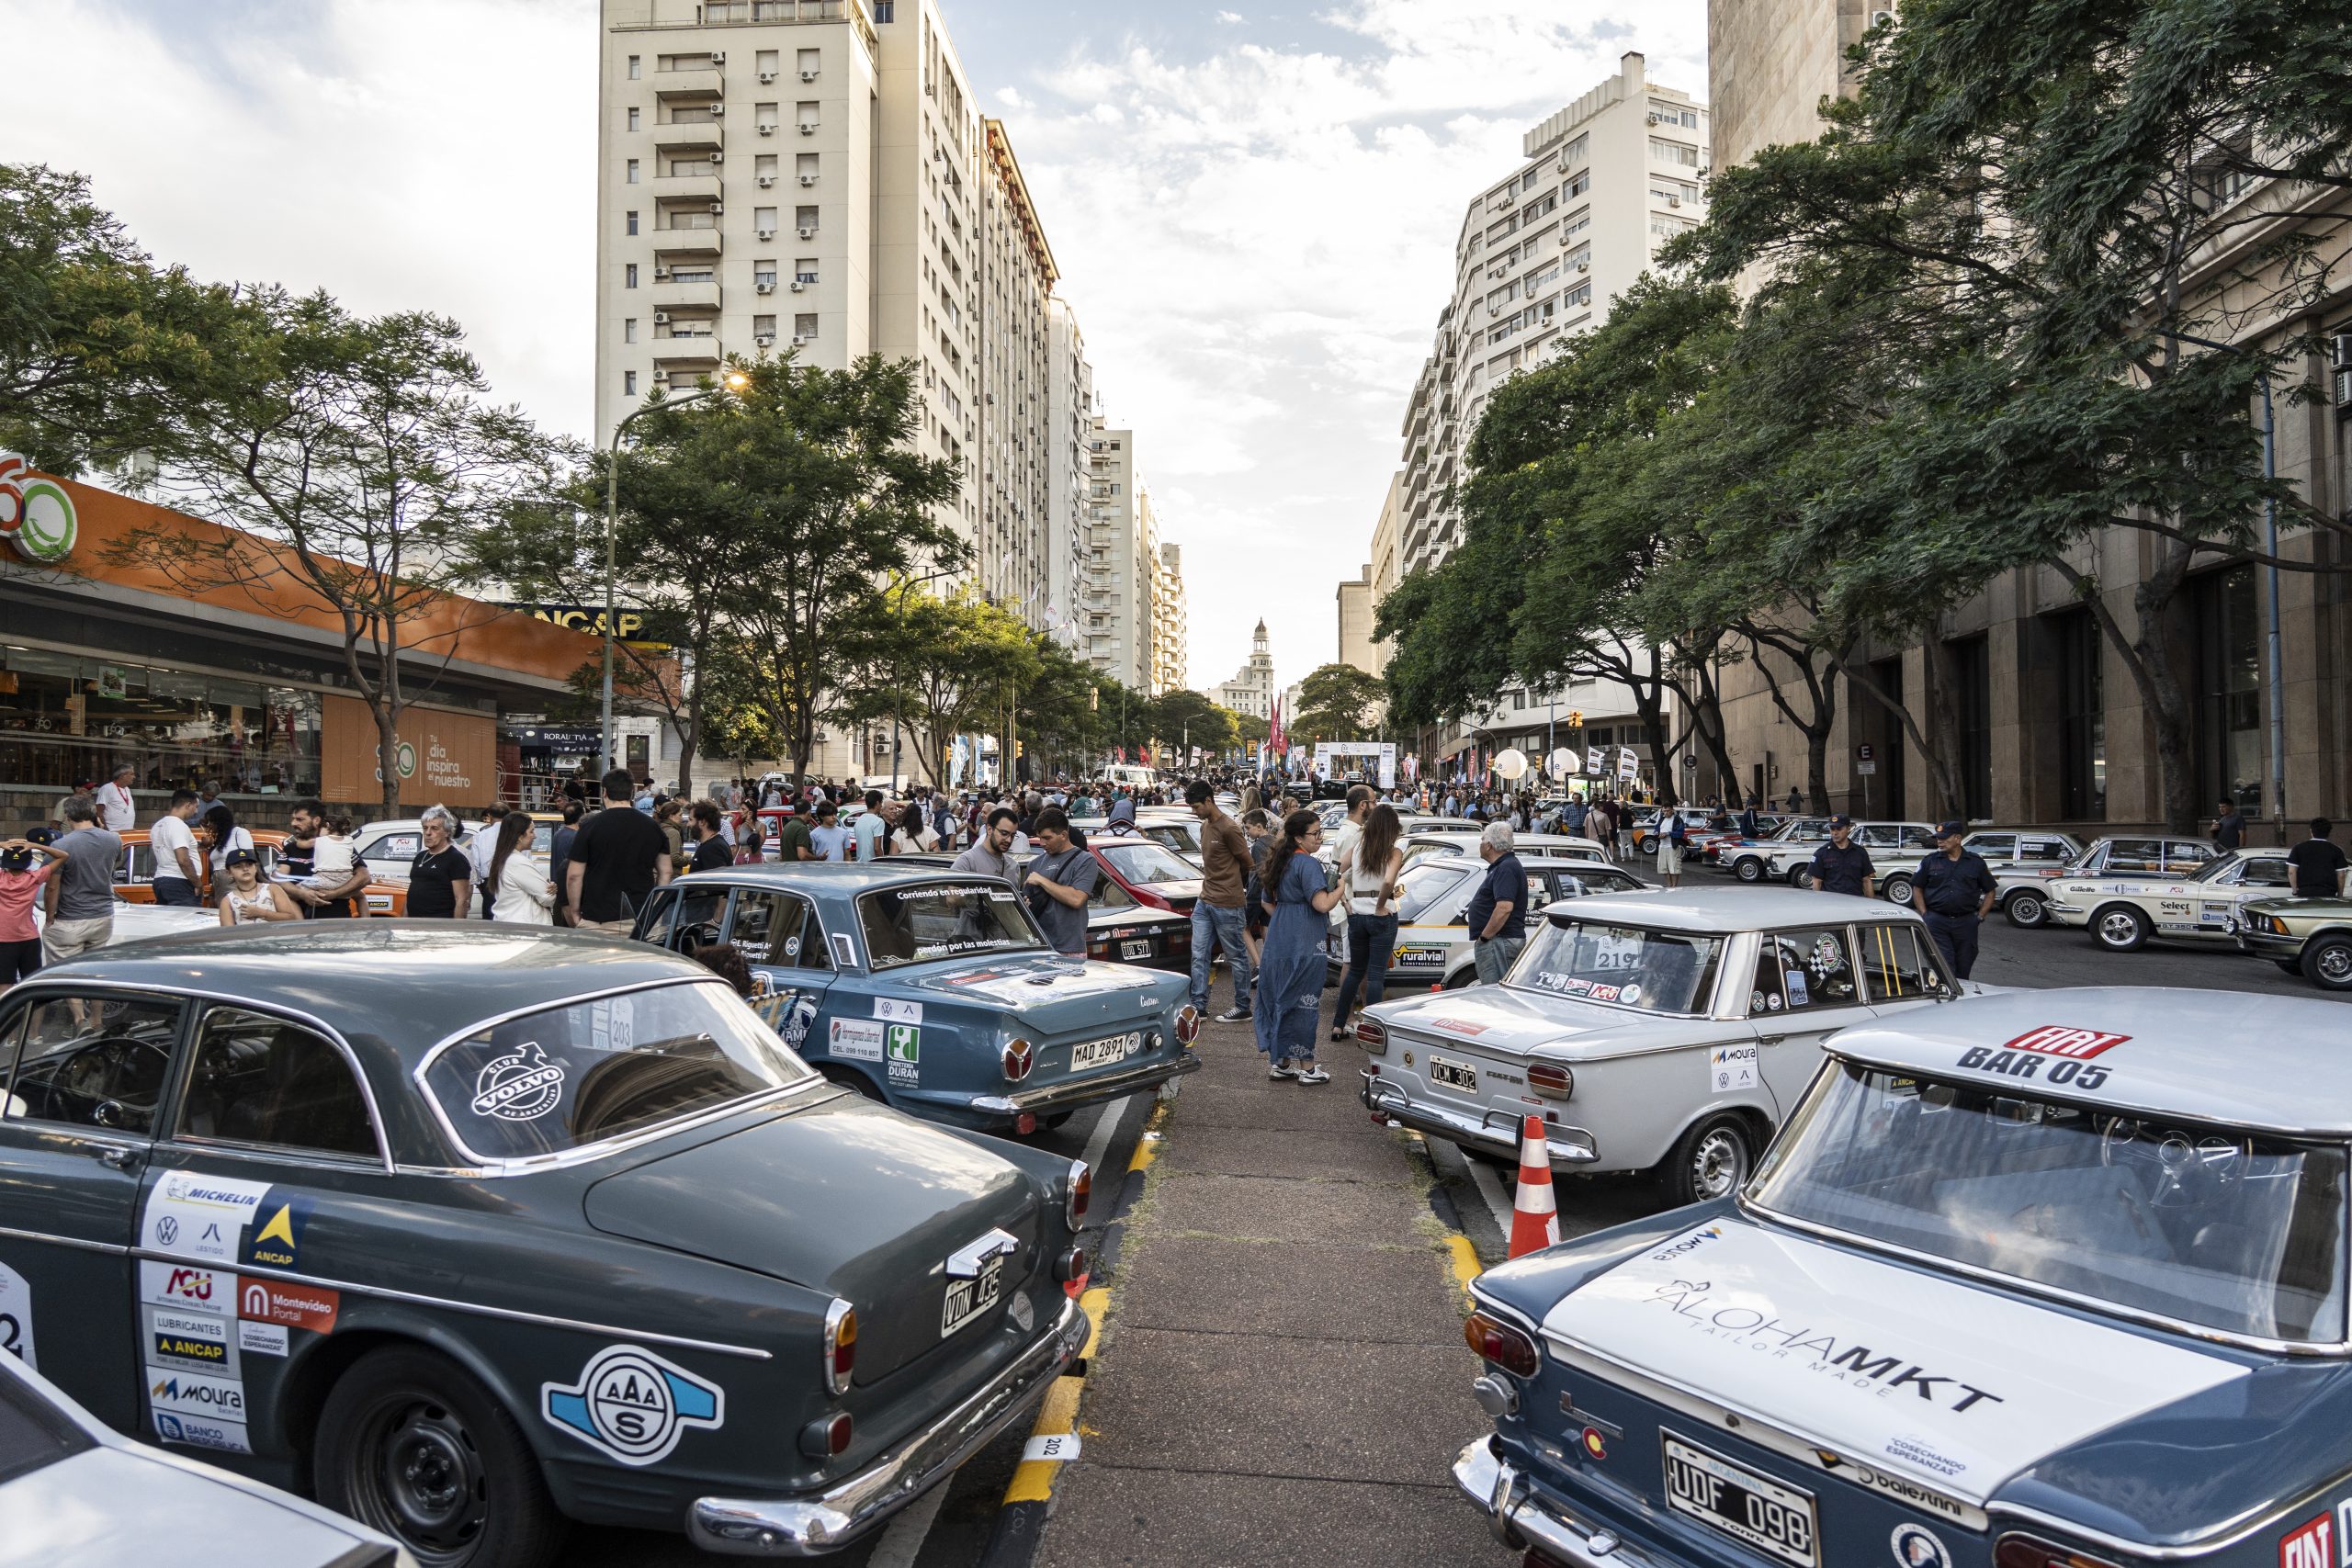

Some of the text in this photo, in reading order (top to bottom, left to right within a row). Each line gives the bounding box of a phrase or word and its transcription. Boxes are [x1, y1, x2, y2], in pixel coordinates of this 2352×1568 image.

[514, 609, 643, 637] NCAP
[430, 734, 437, 743] Tu
[1861, 745, 1870, 759] E
[426, 757, 459, 774] inspira
[435, 774, 470, 788] nuestro
[897, 886, 992, 900] Corriendo en regularidad
[2160, 900, 2189, 910] Select
[742, 940, 764, 950] Riguetti
[917, 938, 1011, 955] perdón por las molestias
[1137, 943, 1149, 955] 577
[1822, 945, 1836, 959] FIAT
[1403, 950, 1444, 962] ruralvial
[1589, 985, 1619, 1000] ACU
[613, 1020, 631, 1047] 203
[2015, 1026, 2123, 1056] FIAT
[1074, 1037, 1124, 1064] MAD 2891
[488, 1057, 521, 1075] CLUB
[1088, 1057, 1108, 1066] URUGUAY
[1956, 1046, 2113, 1090] BAR 05
[888, 1066, 919, 1079] DURAN
[1431, 1062, 1476, 1089] VCM 302
[475, 1068, 560, 1109] VOLVO
[503, 1088, 557, 1117] DE ARGENTINA
[187, 1188, 259, 1206] MICHELIN
[196, 1244, 224, 1256] LESTIDO
[254, 1250, 294, 1265] ANCAP
[166, 1267, 212, 1301] ACU
[273, 1294, 331, 1314] Montevideo
[945, 1269, 1001, 1327] VDN 435
[273, 1306, 301, 1322] Portal
[157, 1317, 222, 1337] LUBRICANTES
[175, 1339, 223, 1359] ANCAP
[1690, 1321, 1894, 1398] TAILOR MADE
[606, 1374, 658, 1406] AAA
[185, 1424, 224, 1440] BANCO
[616, 1411, 646, 1438] S
[1043, 1438, 1062, 1456] 202
[1705, 1461, 1764, 1494] ARGENTINA
[1876, 1472, 1963, 1517] balestrini
[1671, 1459, 1807, 1551] UDF 098
